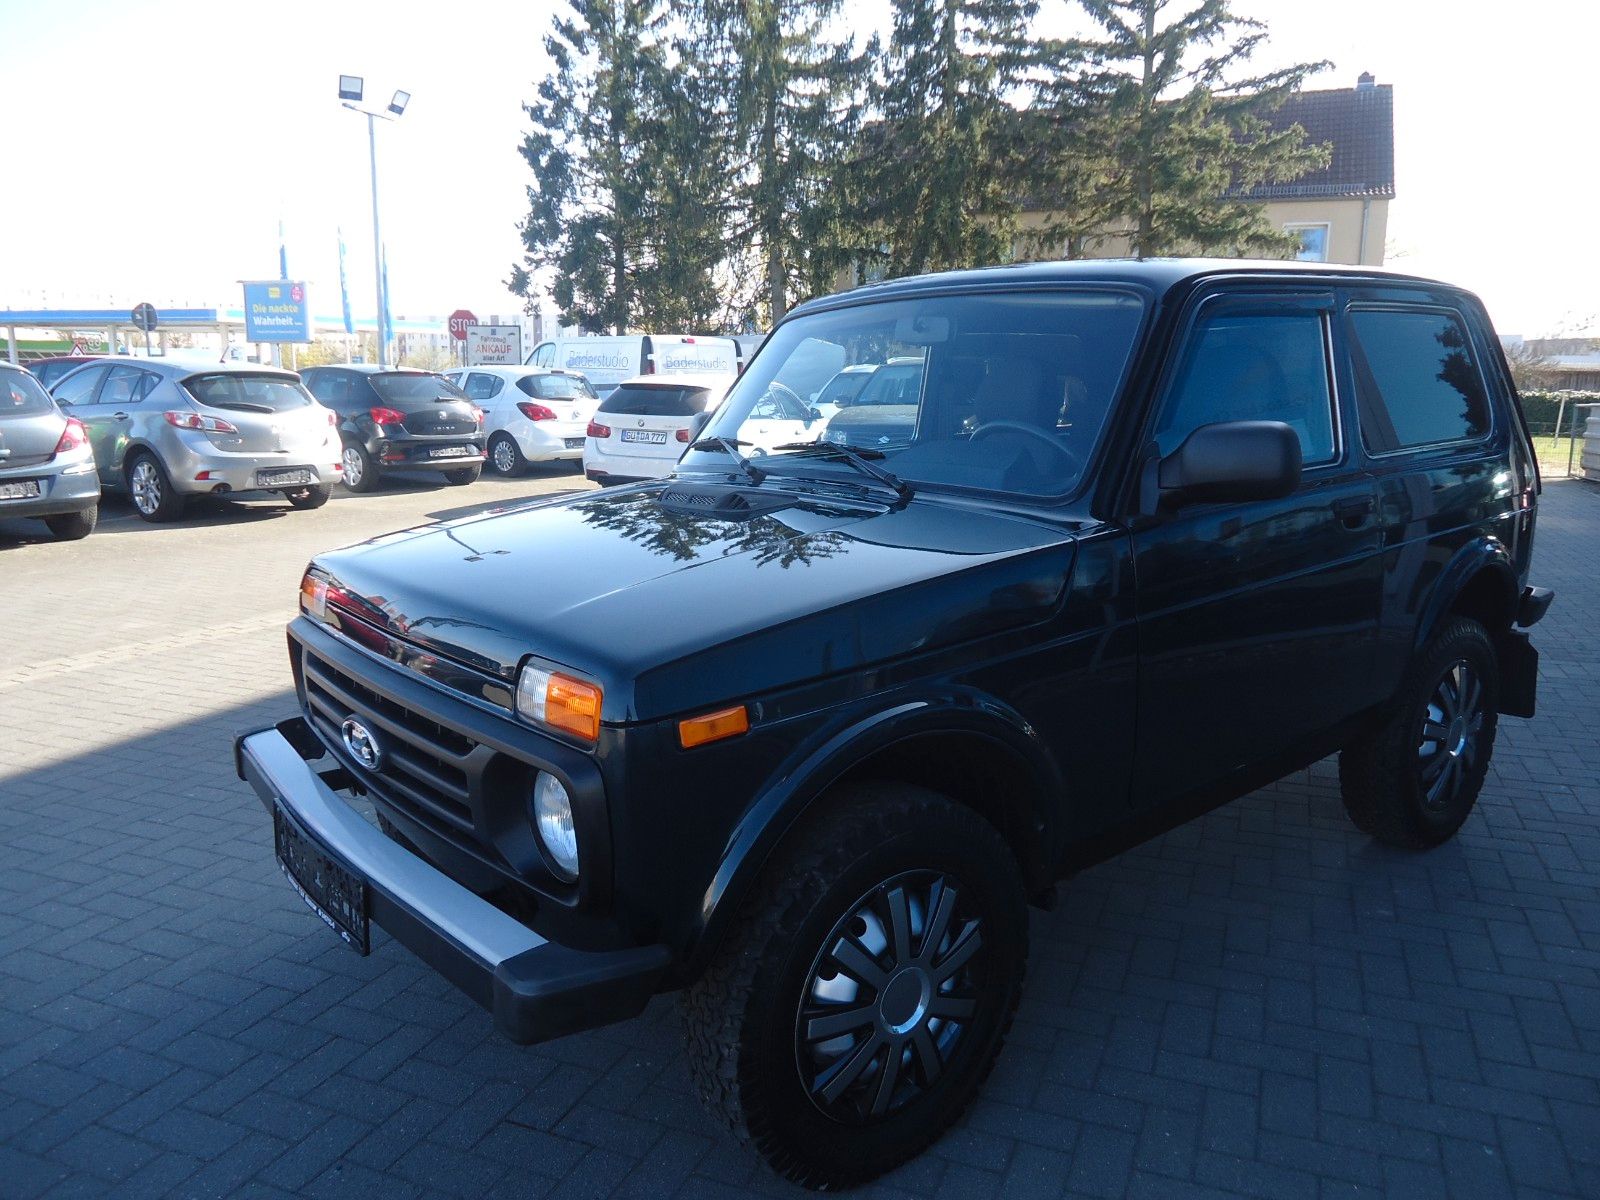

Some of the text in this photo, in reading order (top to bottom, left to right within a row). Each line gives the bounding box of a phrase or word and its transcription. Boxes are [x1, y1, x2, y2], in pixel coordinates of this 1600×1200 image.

[252, 304, 267, 313] Die
[253, 315, 293, 326] Wahrheit
[475, 344, 512, 354] ANKAUF
[664, 355, 728, 369] Bäderstudio
